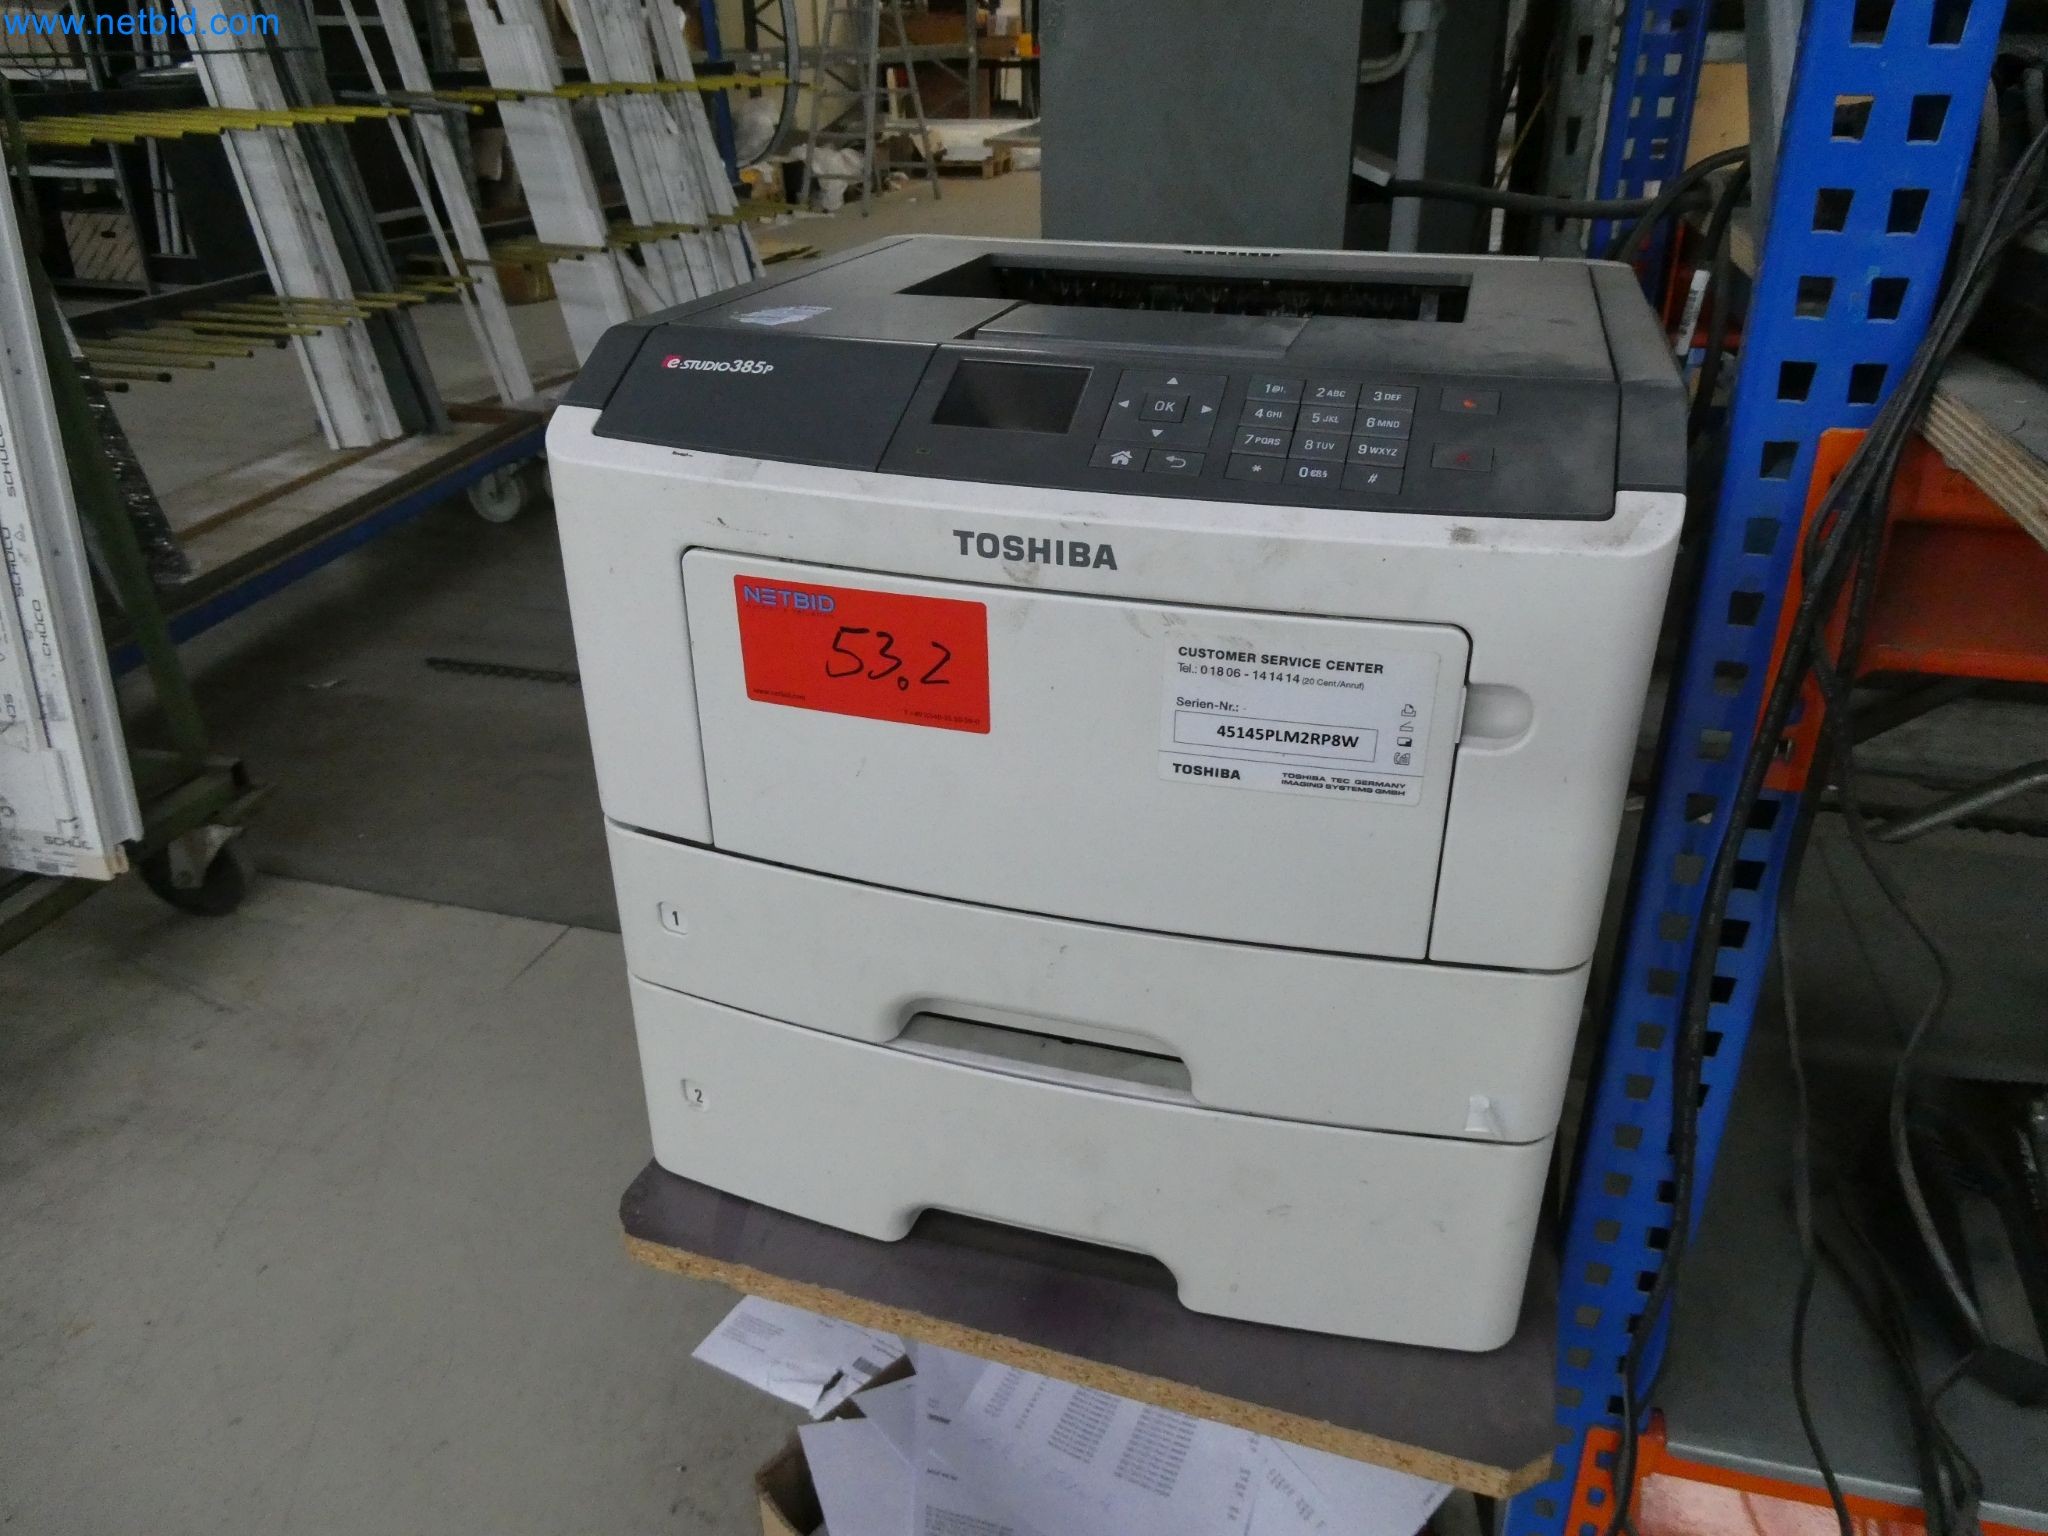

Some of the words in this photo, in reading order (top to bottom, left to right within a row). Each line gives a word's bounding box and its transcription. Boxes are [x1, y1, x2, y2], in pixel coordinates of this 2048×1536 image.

[1316, 387, 1325, 398] 2
[1326, 390, 1346, 398] ABC
[1373, 391, 1382, 401] 3
[1384, 393, 1402, 401] DEF
[1154, 400, 1176, 412] OK
[1254, 408, 1263, 418] 4
[1266, 411, 1283, 419] GHI
[1312, 413, 1320, 423] 5
[1366, 417, 1376, 428] 6
[1244, 434, 1254, 445] 7
[1254, 436, 1281, 446] PQRS
[1304, 439, 1314, 450] 8
[1316, 442, 1335, 450] TUV
[1358, 444, 1368, 455] 9
[1369, 446, 1398, 457] WXYZ
[1299, 467, 1309, 478] 0
[953, 529, 1118, 571] TOSHIBA
[743, 584, 835, 612] NETBID
[825, 626, 952, 691] 53.2
[1178, 646, 1257, 664] CUSTOMER
[1261, 654, 1322, 670] SERVICE
[1326, 660, 1384, 675] CENTER
[1301, 676, 1315, 686] (20
[1176, 696, 1240, 713] Serien-Nr.:
[1216, 725, 1360, 748] 45145PLM2RP8W
[1172, 762, 1241, 781] TOSHIBA
[1281, 772, 1327, 783] TOSHIBA
[1330, 776, 1351, 785] TEC
[1354, 778, 1406, 790] GERMANY
[1281, 779, 1324, 790] IMAGING
[1325, 784, 1374, 794] SYSTEMS
[671, 910, 680, 927] 1
[694, 1088, 704, 1104] 2
